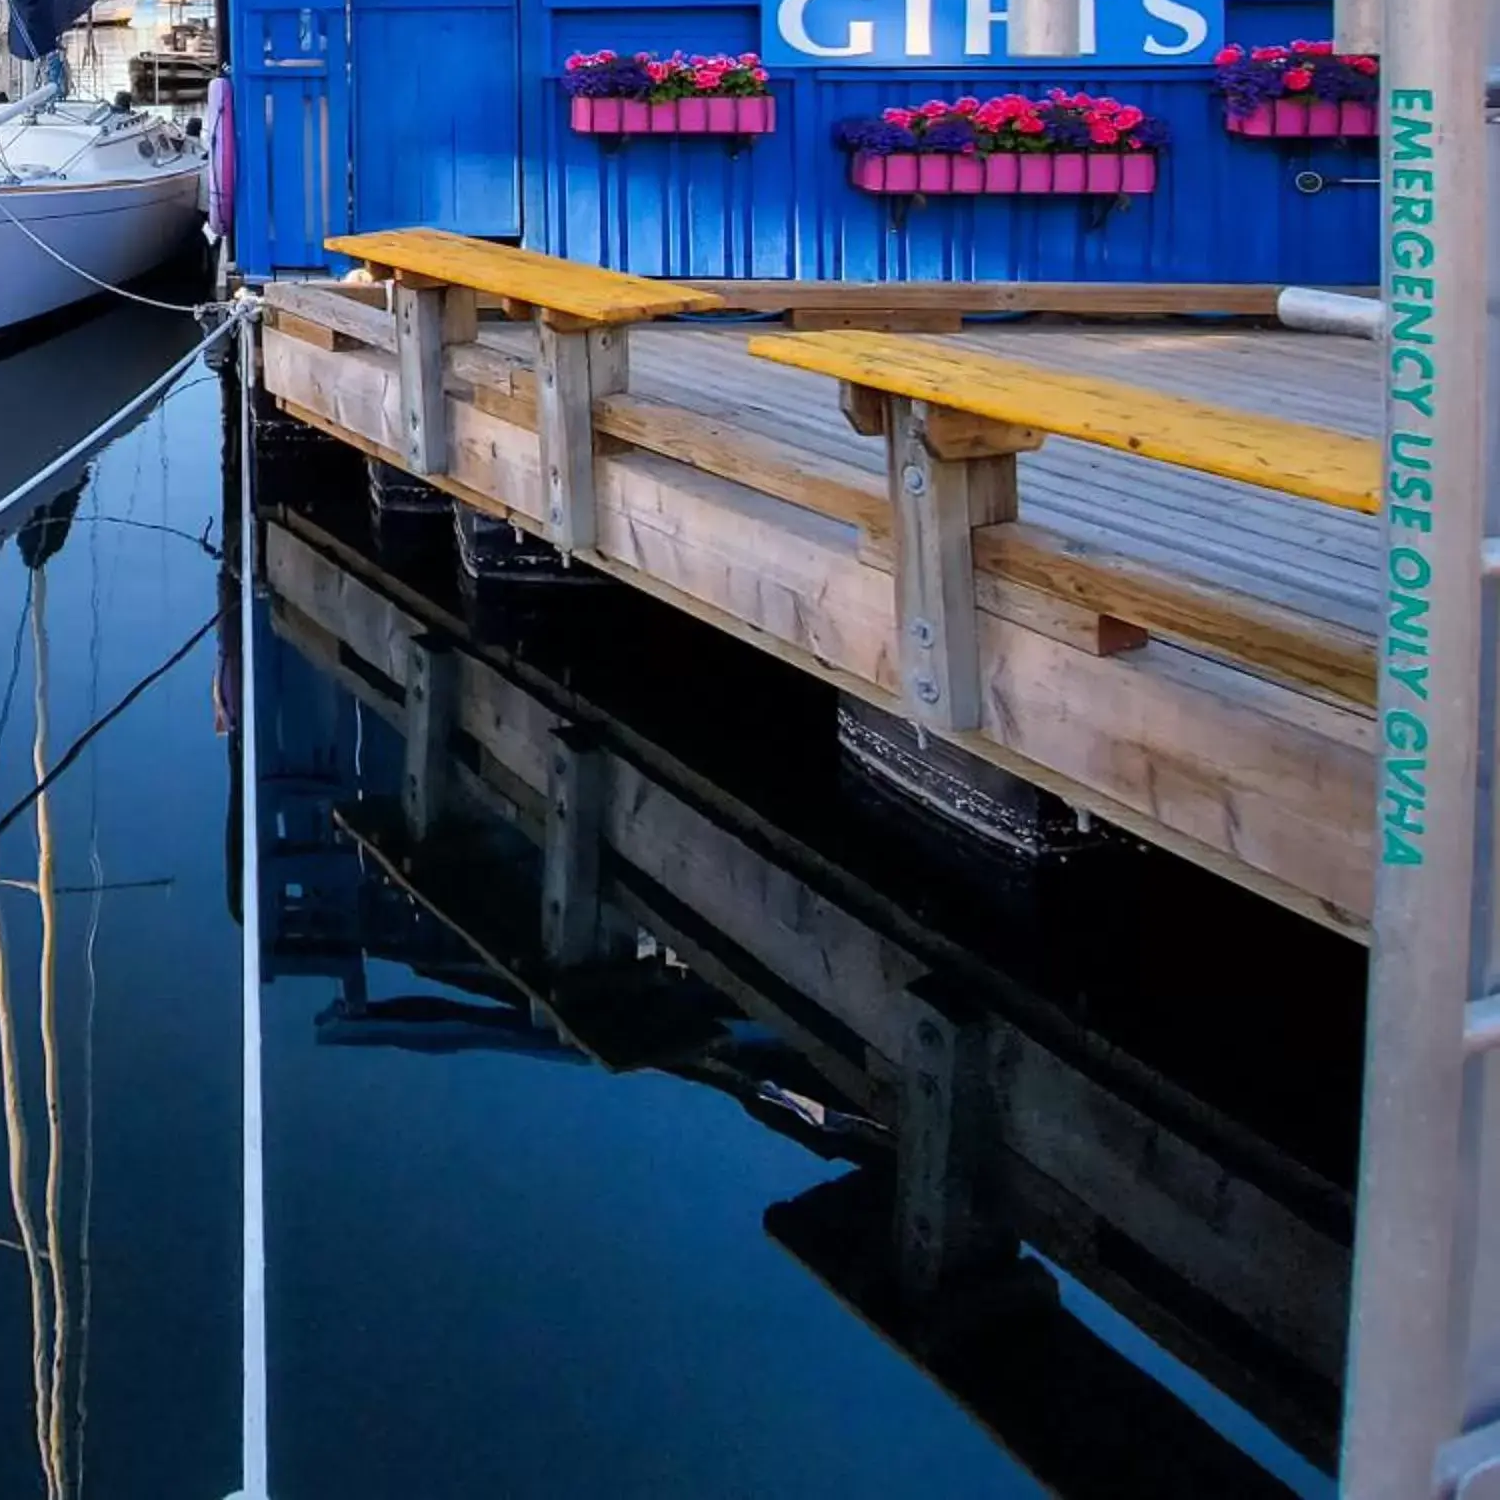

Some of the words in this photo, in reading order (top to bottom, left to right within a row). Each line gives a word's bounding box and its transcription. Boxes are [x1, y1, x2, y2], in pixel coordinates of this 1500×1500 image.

[1391, 88, 1435, 418] EMERGENCY
[1390, 431, 1434, 534] USE
[1388, 546, 1432, 701] ONLY
[1382, 709, 1430, 866] GVHA
